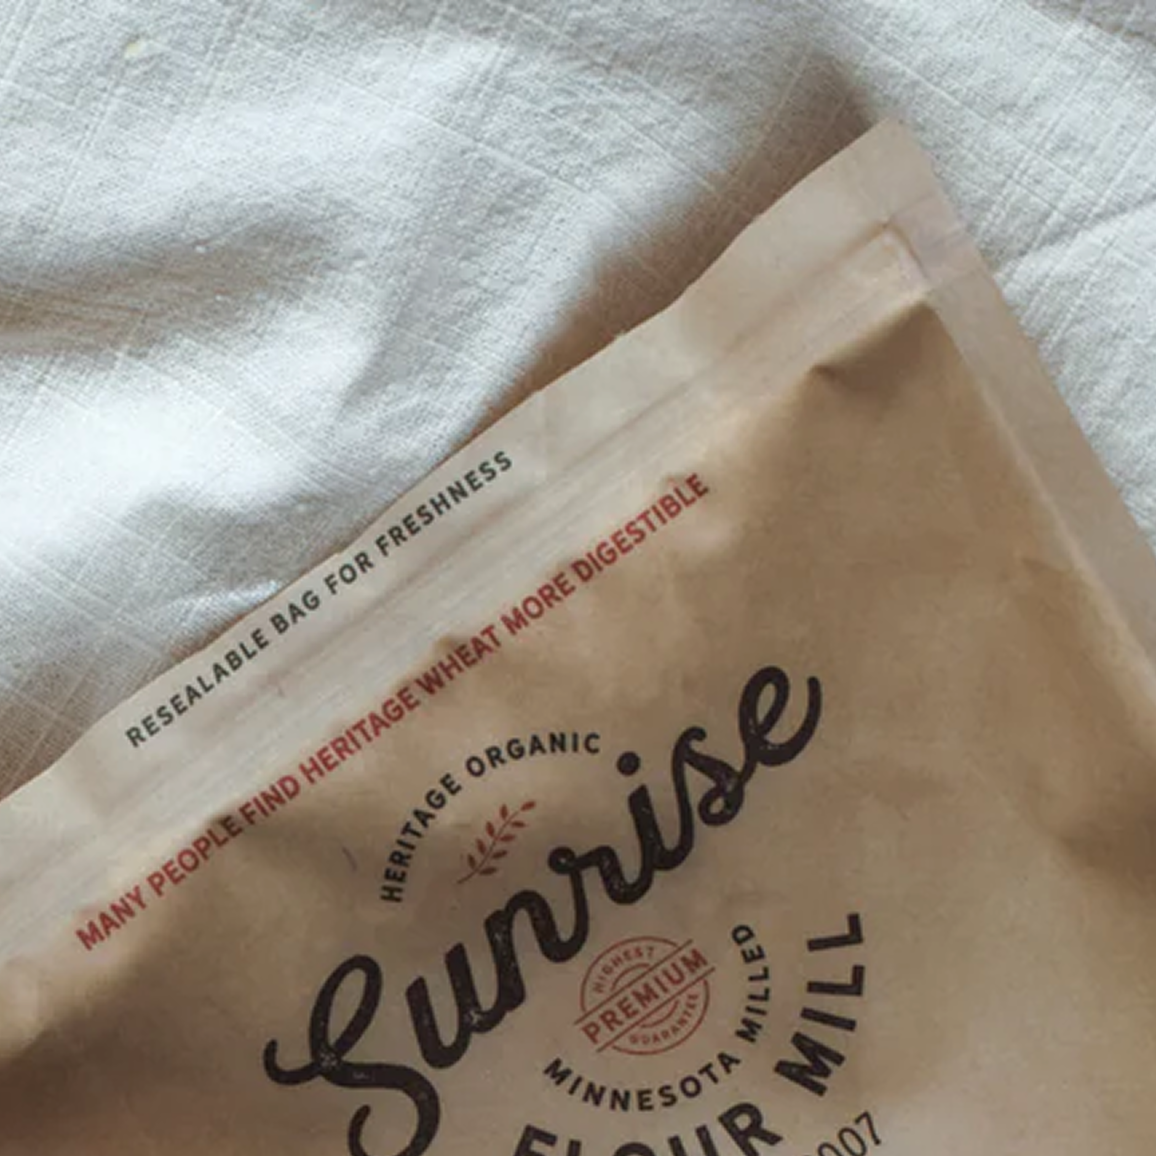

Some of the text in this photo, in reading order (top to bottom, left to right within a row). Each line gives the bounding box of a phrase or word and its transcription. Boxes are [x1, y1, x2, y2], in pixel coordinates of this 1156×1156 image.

[124, 450, 513, 748] RESEALABLE BAG FOR FRESHNESS
[75, 472, 710, 951] MANY PEOPLE FIND HERITAGE WHEAT MORE DIGESTIBLE
[380, 732, 602, 903] HERITAGE ORGANIC
[543, 923, 770, 1112] MINNESOTA MILLED
[581, 948, 709, 1045] PREMIUM
[774, 912, 865, 1097] MILL
